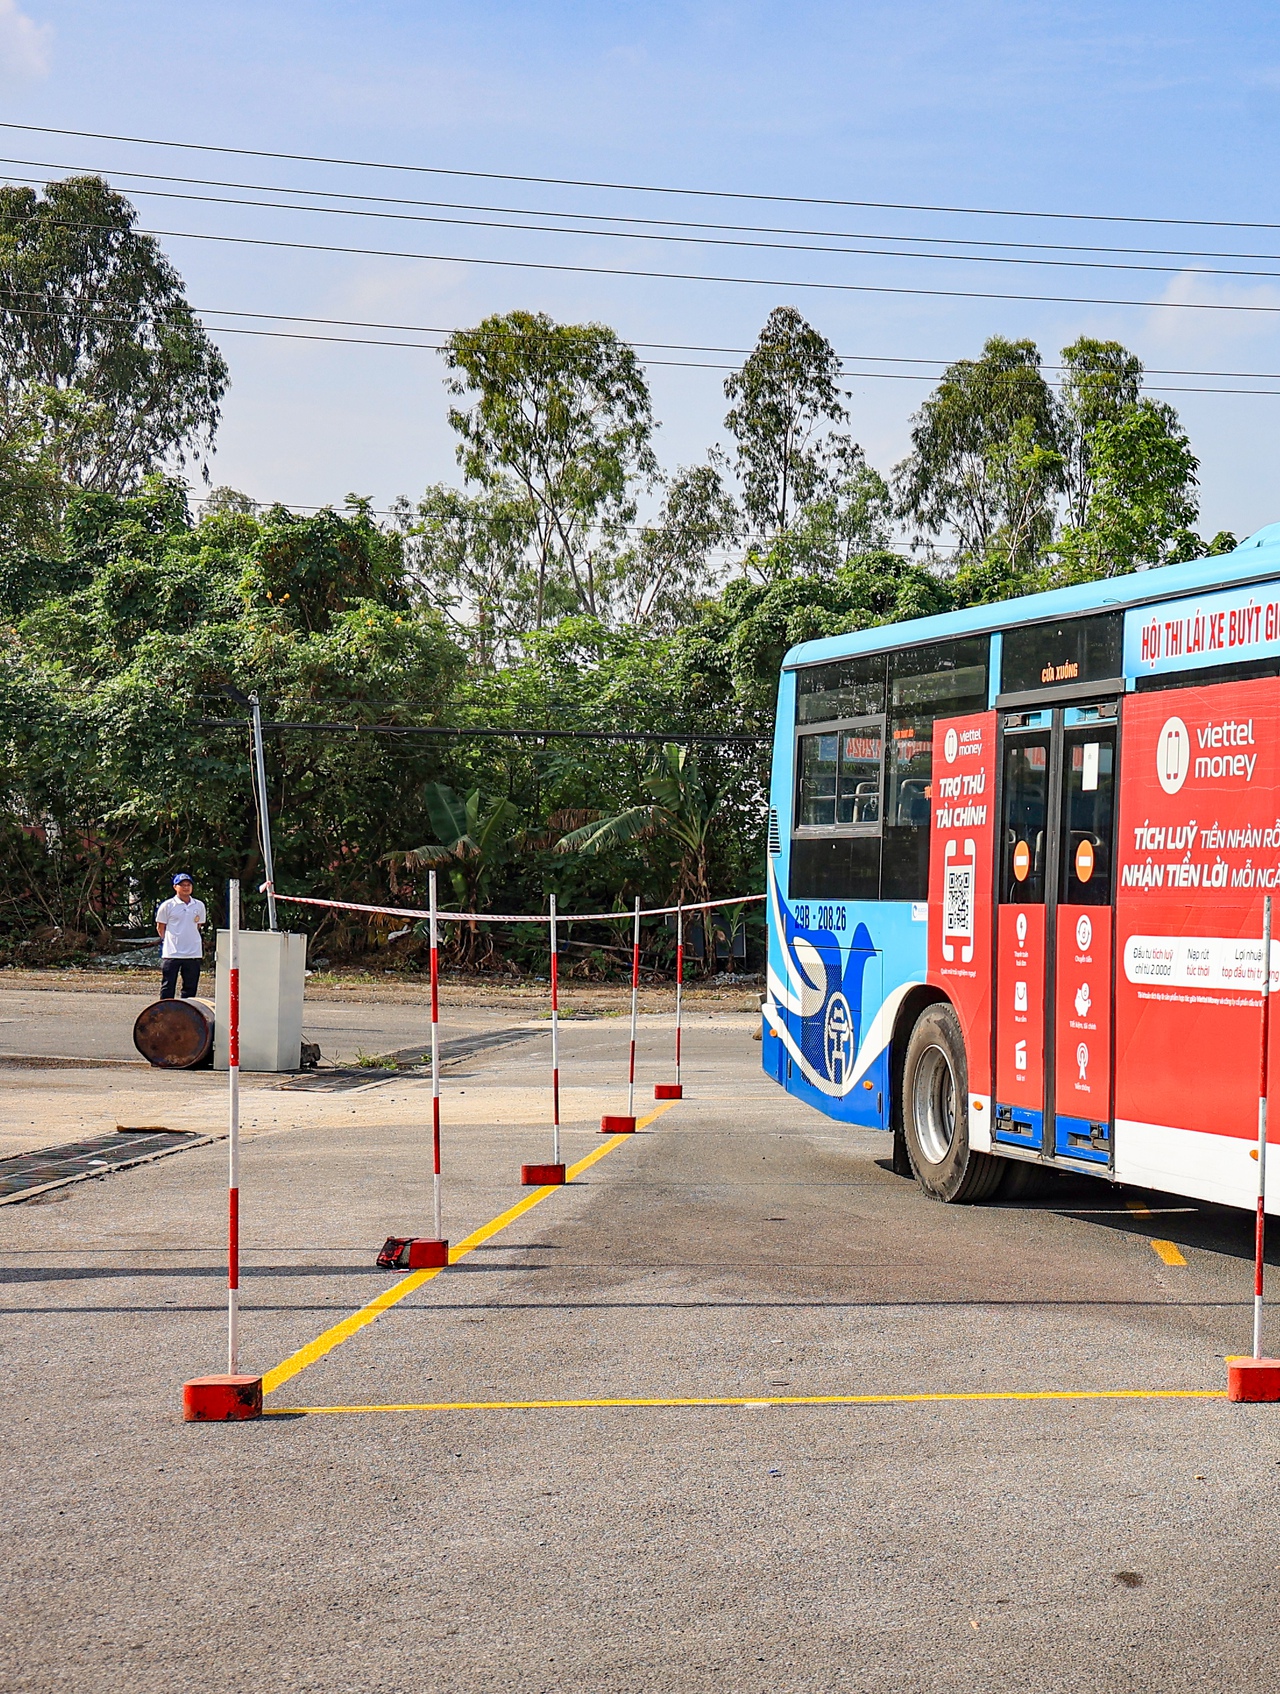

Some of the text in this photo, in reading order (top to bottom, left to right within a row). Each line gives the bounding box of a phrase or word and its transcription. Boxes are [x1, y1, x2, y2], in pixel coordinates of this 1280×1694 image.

[1141, 617, 1161, 668] HỘI
[1165, 621, 1183, 656] THI
[1186, 608, 1205, 653] LÁI
[1208, 612, 1225, 649] XE
[1228, 599, 1261, 647] BUÝT
[1041, 661, 1055, 683] CỬA
[959, 728, 982, 743] viettel
[1197, 719, 1255, 749] viettel
[958, 743, 982, 756] money
[1195, 753, 1258, 782] money
[939, 774, 962, 801] TRỢ
[963, 767, 986, 795] THỦ
[936, 799, 987, 829] TÀI CHÍNH
[1134, 819, 1166, 850] TÍCH
[1200, 821, 1226, 849] TIỀN
[1121, 856, 1165, 892] NHẬN
[1166, 851, 1201, 888] TIỀN
[1202, 855, 1229, 888] LỜI
[1231, 859, 1255, 888] MỖI
[794, 905, 810, 929] 29B
[818, 905, 847, 931] 208.26
[1222, 966, 1233, 980] top
